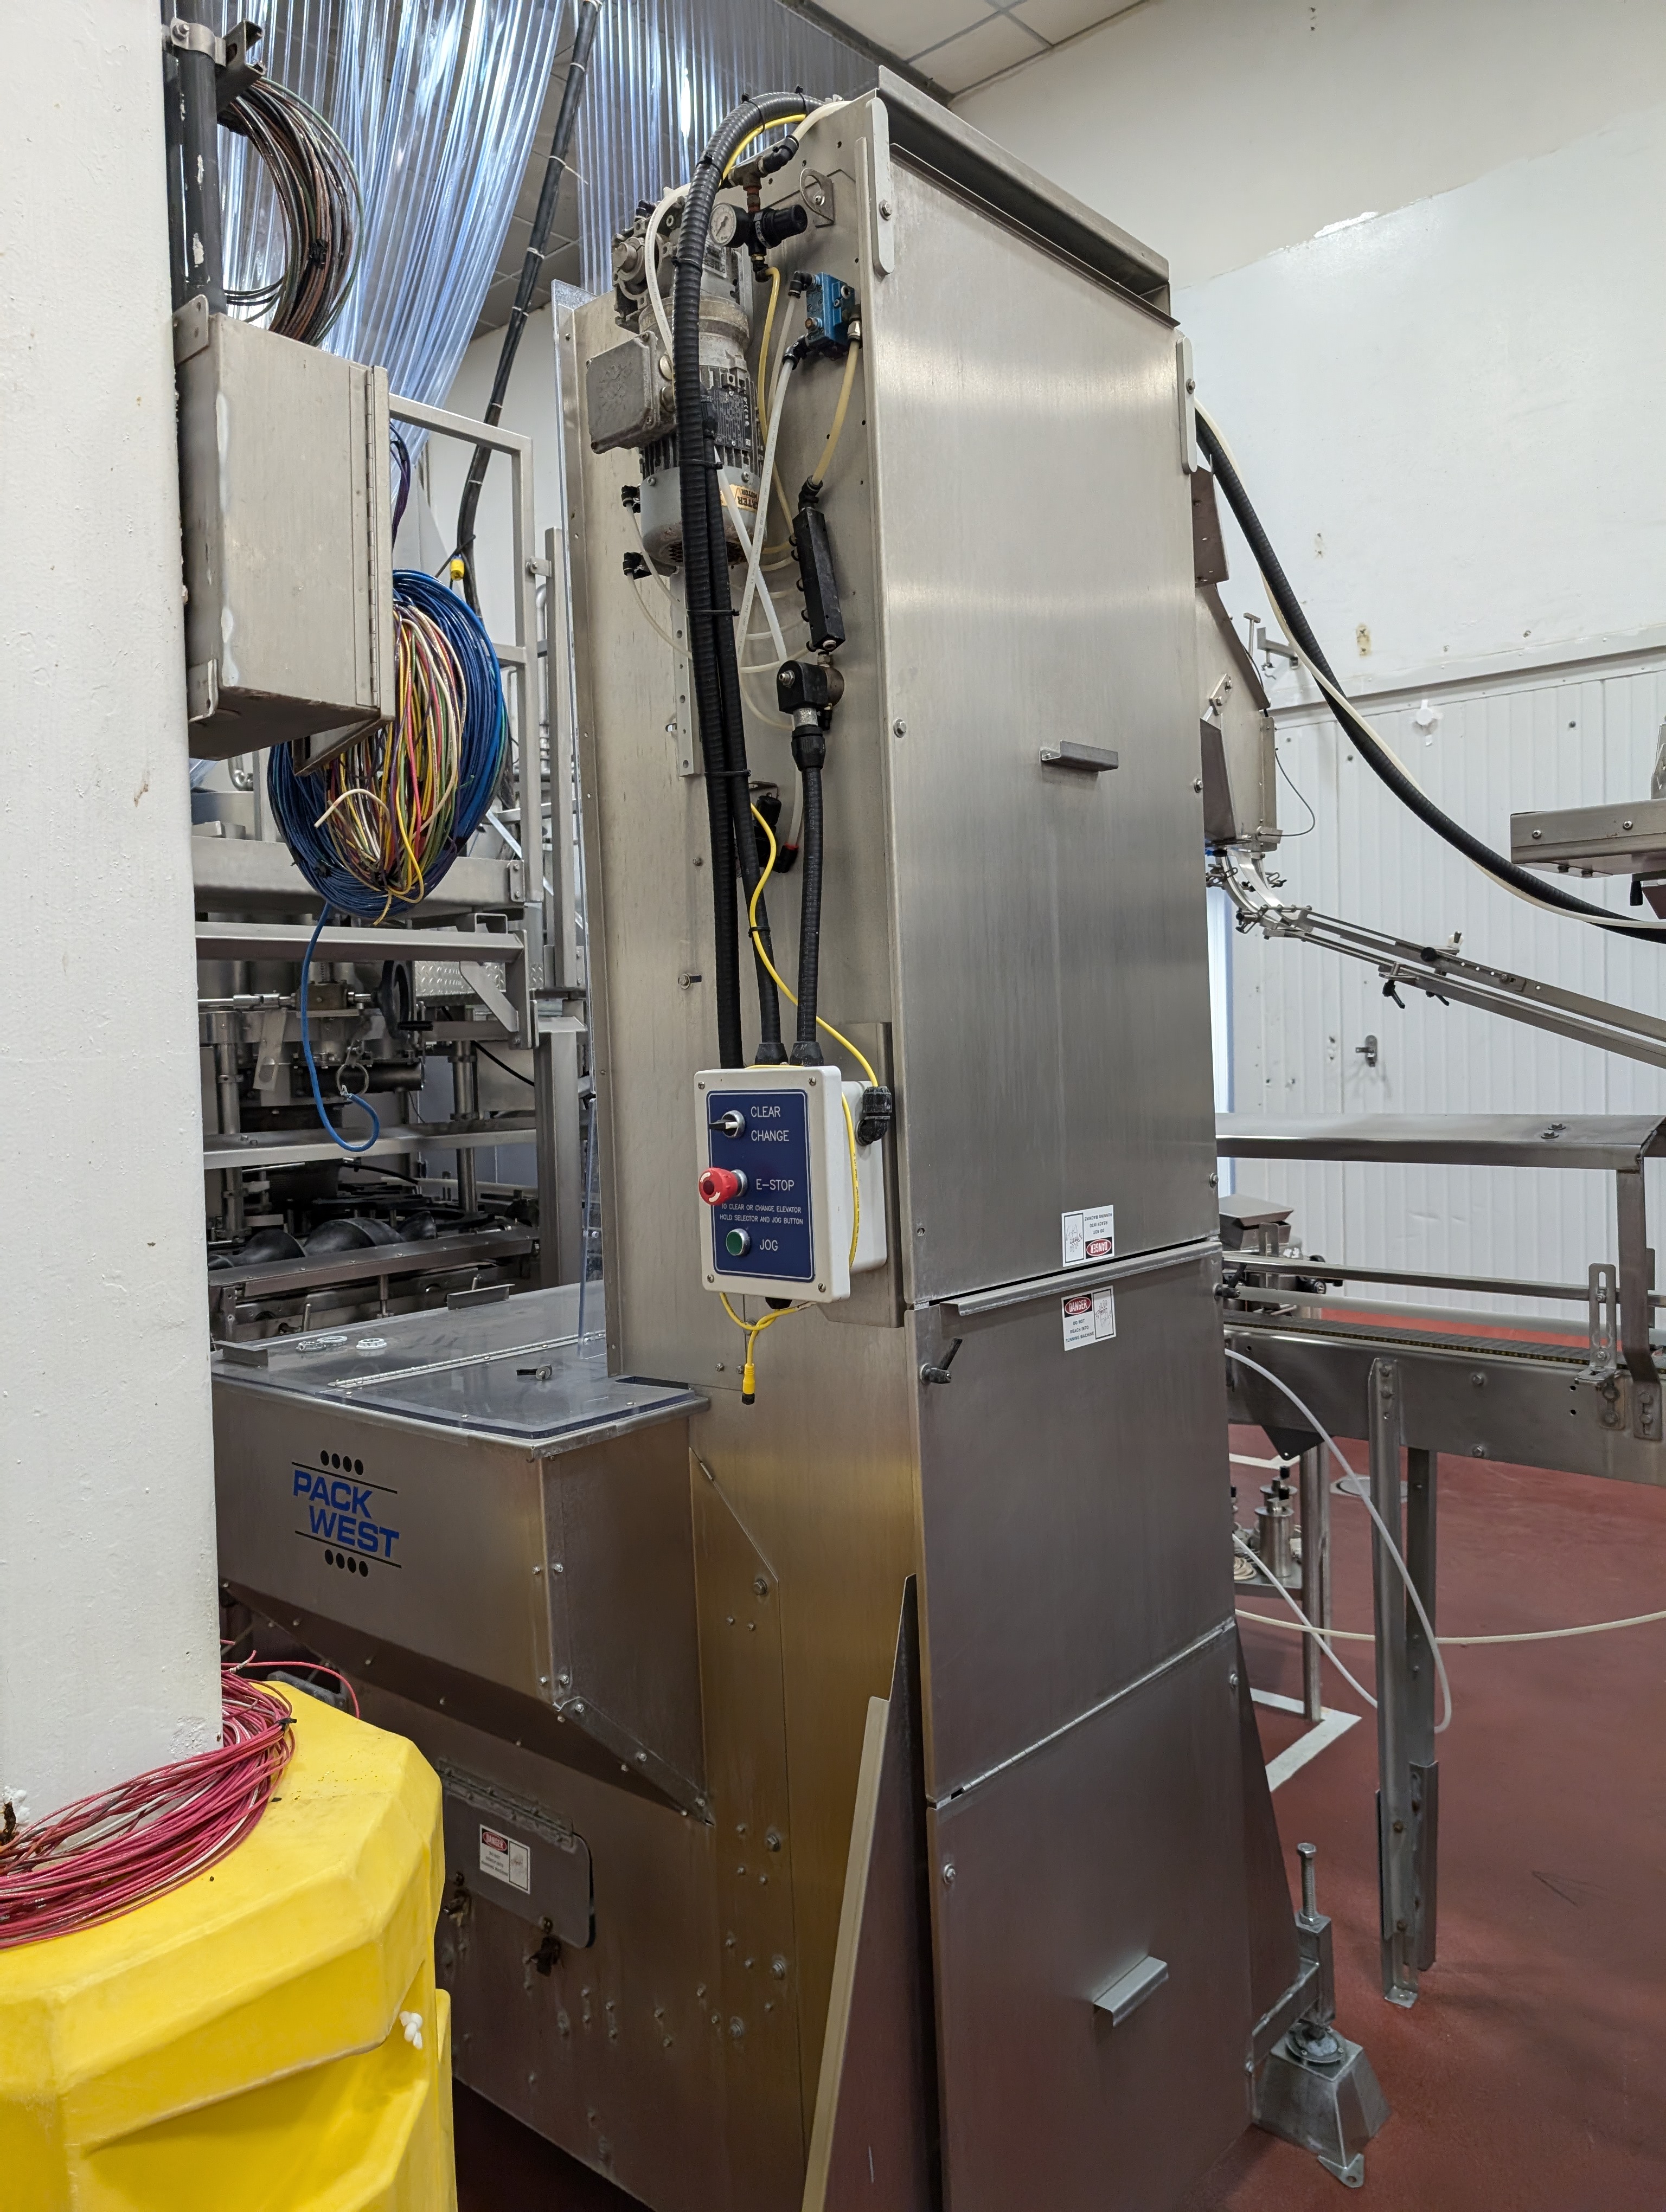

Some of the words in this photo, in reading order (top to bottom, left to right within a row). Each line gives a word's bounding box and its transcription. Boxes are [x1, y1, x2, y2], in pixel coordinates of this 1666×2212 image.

[751, 1106, 781, 1117] CLEAR
[751, 1130, 790, 1142] CHANGE
[756, 1179, 794, 1191] E-STOP
[759, 1239, 778, 1251] JOG
[1090, 1241, 1107, 1253] DANGER
[1068, 1299, 1087, 1313] DANGER
[293, 1469, 373, 1519] PACK
[309, 1504, 400, 1558] WEST
